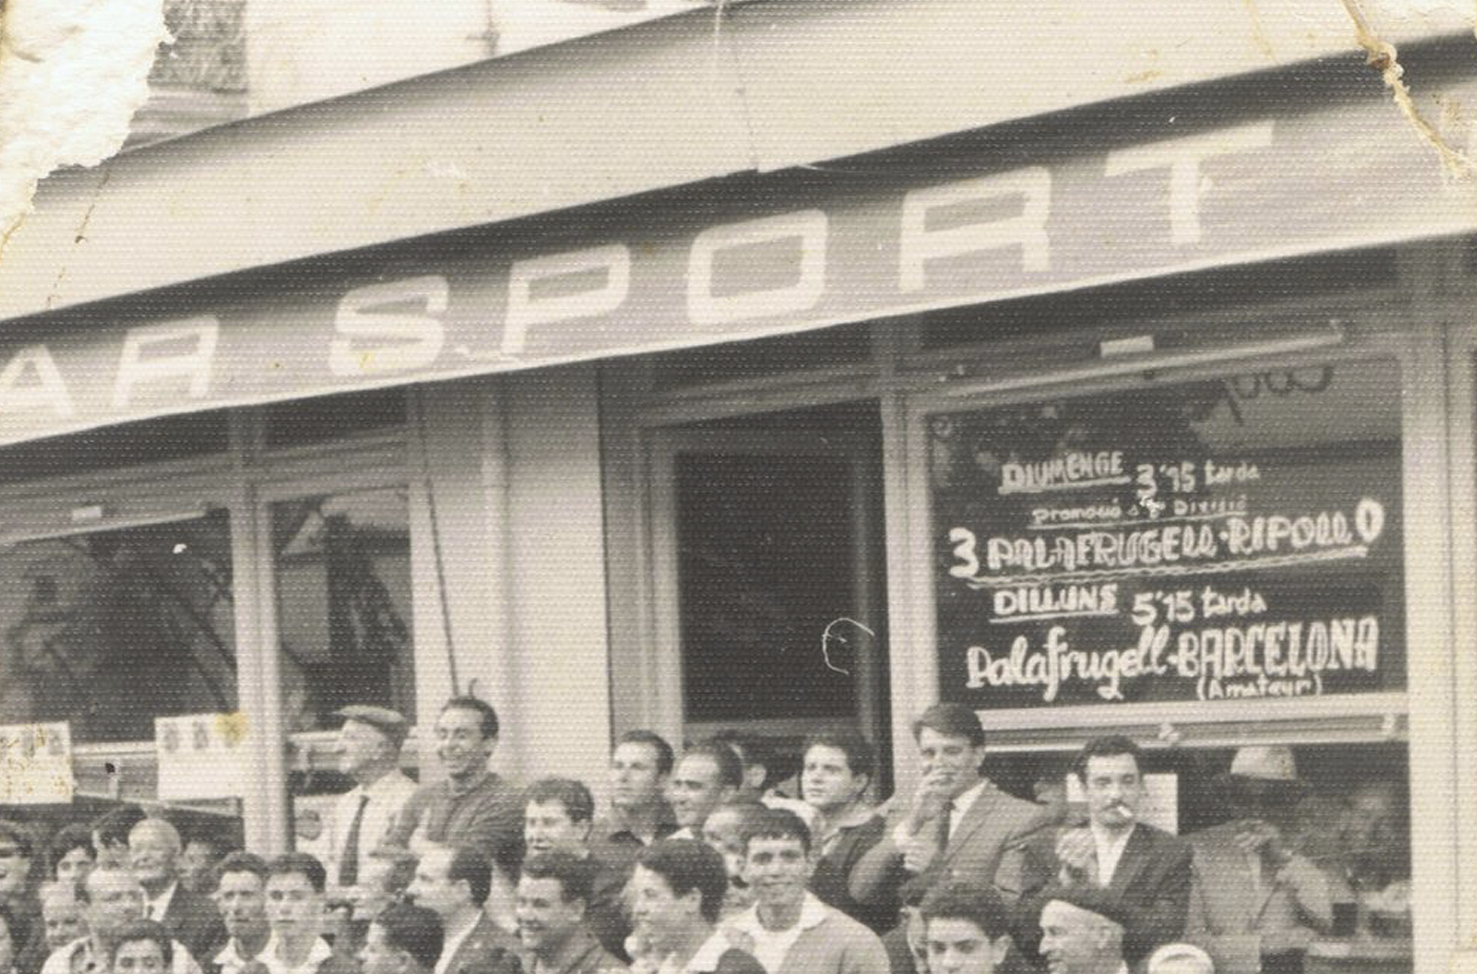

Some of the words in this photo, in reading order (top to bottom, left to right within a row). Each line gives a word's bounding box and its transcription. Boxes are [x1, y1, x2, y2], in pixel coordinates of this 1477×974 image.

[330, 121, 1276, 375] SPORT
[1001, 451, 1124, 488] DIUMENGE
[1205, 459, 1260, 486] tarda
[949, 527, 979, 578] 3
[993, 583, 1118, 616] DILLUNS
[1131, 590, 1196, 626] 5'15
[1202, 585, 1267, 618] tarda
